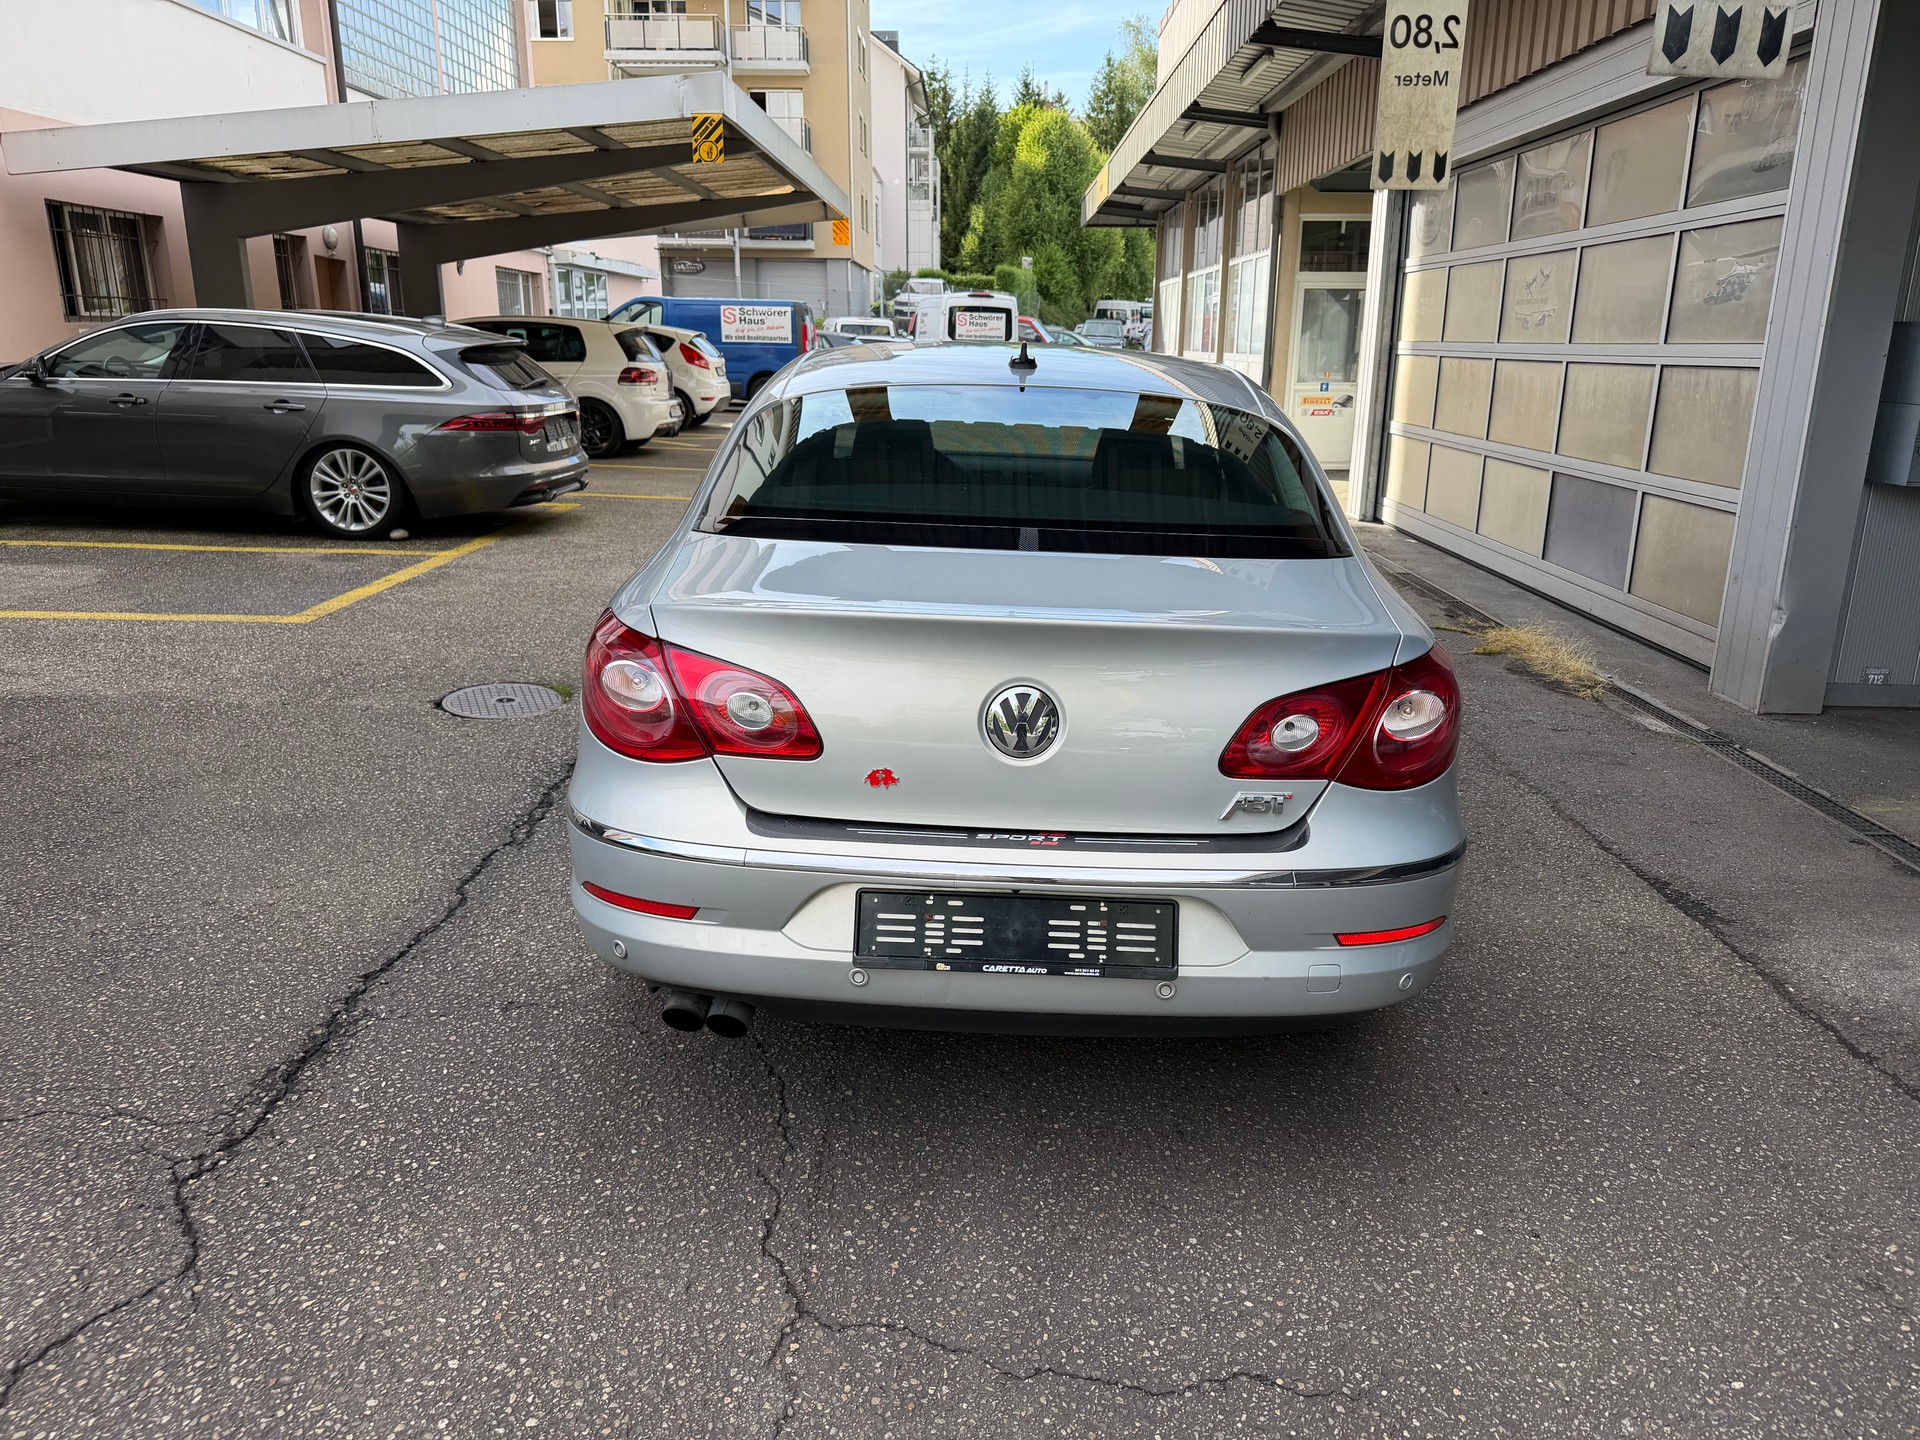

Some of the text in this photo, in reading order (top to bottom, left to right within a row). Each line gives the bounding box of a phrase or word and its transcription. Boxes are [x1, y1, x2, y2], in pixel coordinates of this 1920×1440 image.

[738, 307, 788, 317] Schwörer
[739, 317, 766, 325] Haus
[1868, 674, 1884, 685] 712
[1217, 791, 1293, 820] ABT
[975, 833, 1067, 842] SPORT
[982, 964, 1048, 975] CARETTA AUTO
